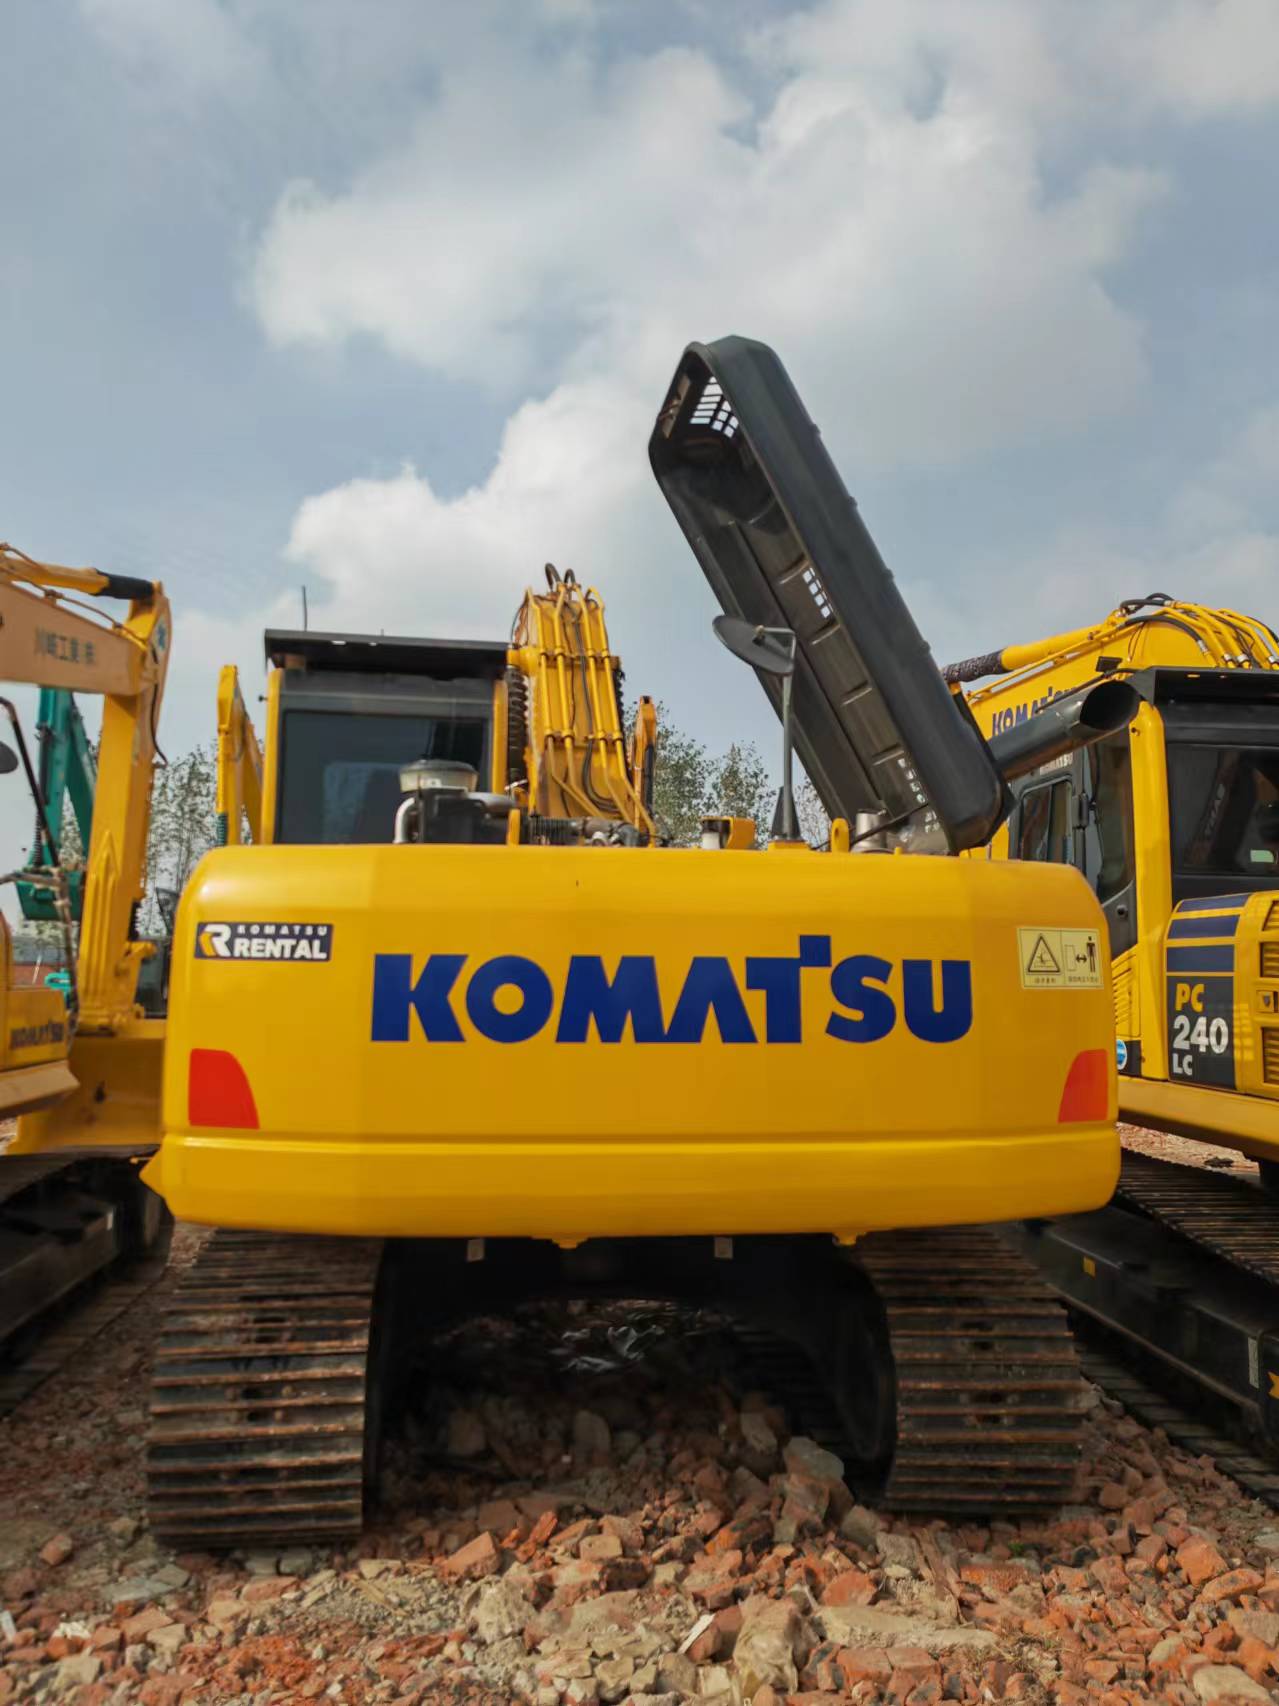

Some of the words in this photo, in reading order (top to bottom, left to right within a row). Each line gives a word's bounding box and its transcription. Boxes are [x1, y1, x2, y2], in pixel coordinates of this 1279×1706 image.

[237, 924, 328, 936] KOMATSU
[233, 938, 327, 959] RENTAL
[371, 935, 973, 1043] KOMATSU
[1175, 983, 1204, 1013] PC
[1173, 1015, 1229, 1054] 240
[1172, 1053, 1193, 1076] LC
